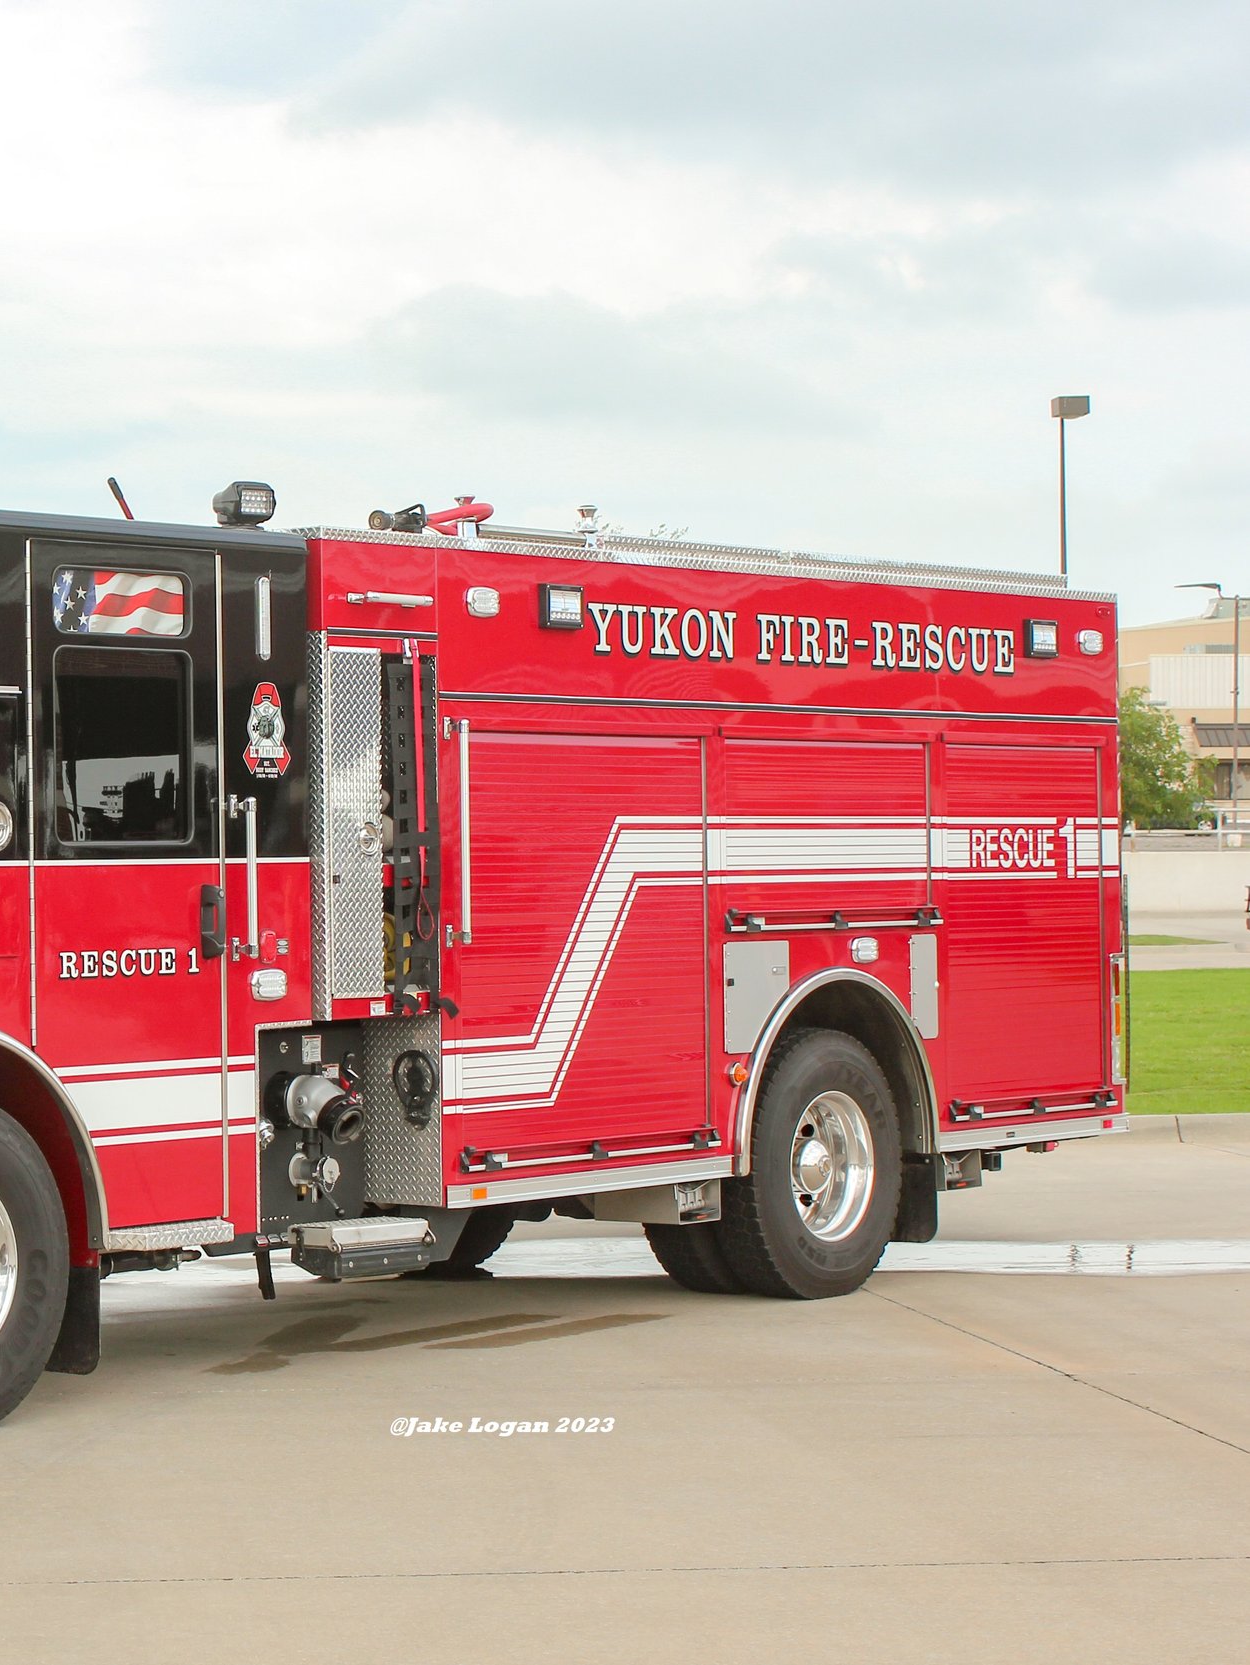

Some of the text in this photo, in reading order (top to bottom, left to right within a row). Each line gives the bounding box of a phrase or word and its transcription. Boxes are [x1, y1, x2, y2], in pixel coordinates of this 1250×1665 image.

[587, 602, 1016, 675] YUKON FIRE-RESCUE
[971, 817, 1075, 878] RESCUE 1
[59, 947, 200, 979] RESCUE 1
